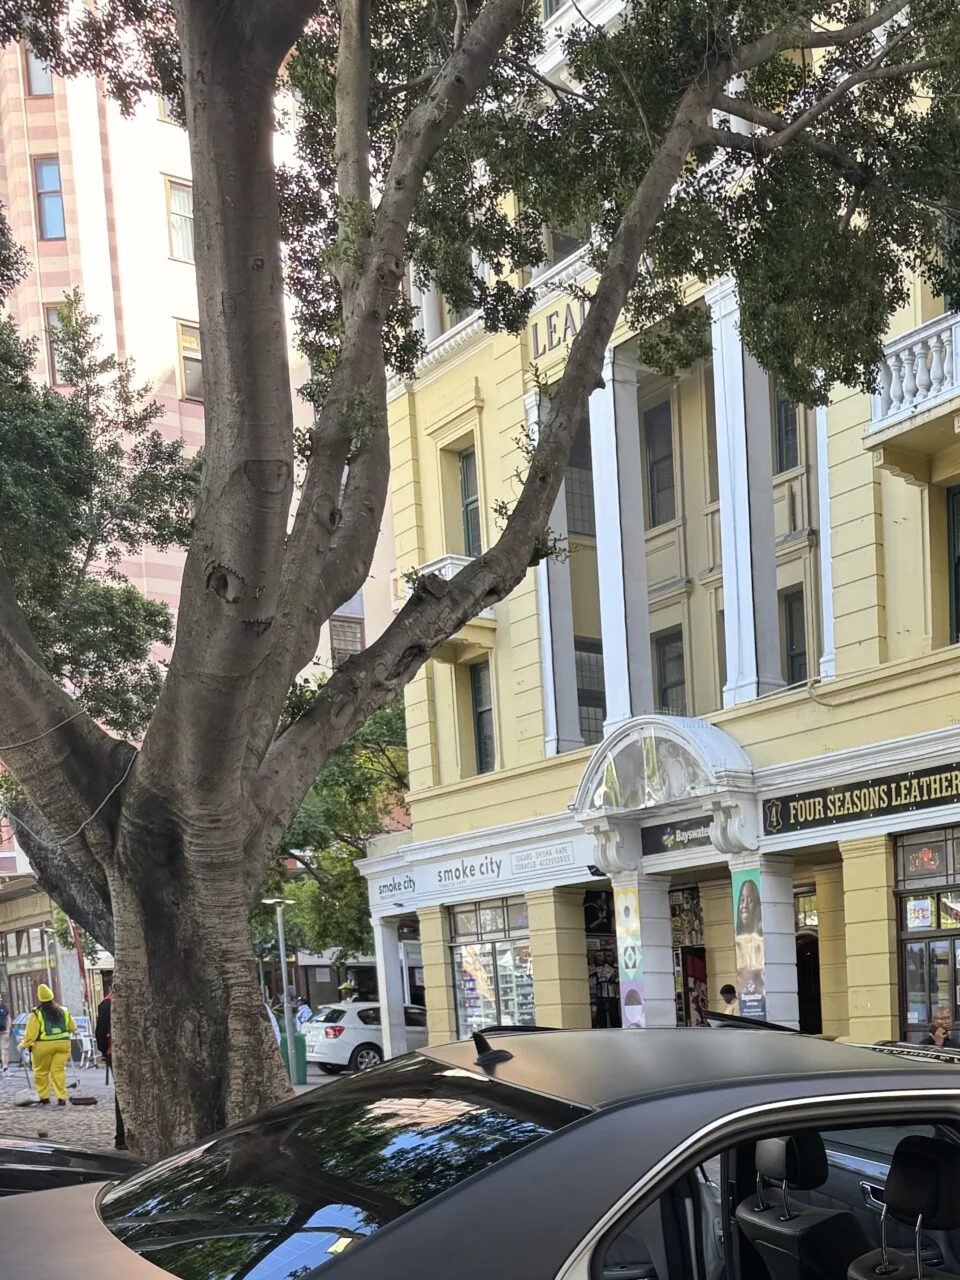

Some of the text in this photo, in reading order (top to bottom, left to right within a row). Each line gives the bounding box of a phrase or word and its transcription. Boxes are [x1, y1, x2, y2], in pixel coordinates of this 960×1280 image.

[789, 797, 825, 825] FOUR
[827, 787, 888, 817] SEASONS
[437, 855, 502, 883] smoke city
[378, 874, 416, 896] smoke city
